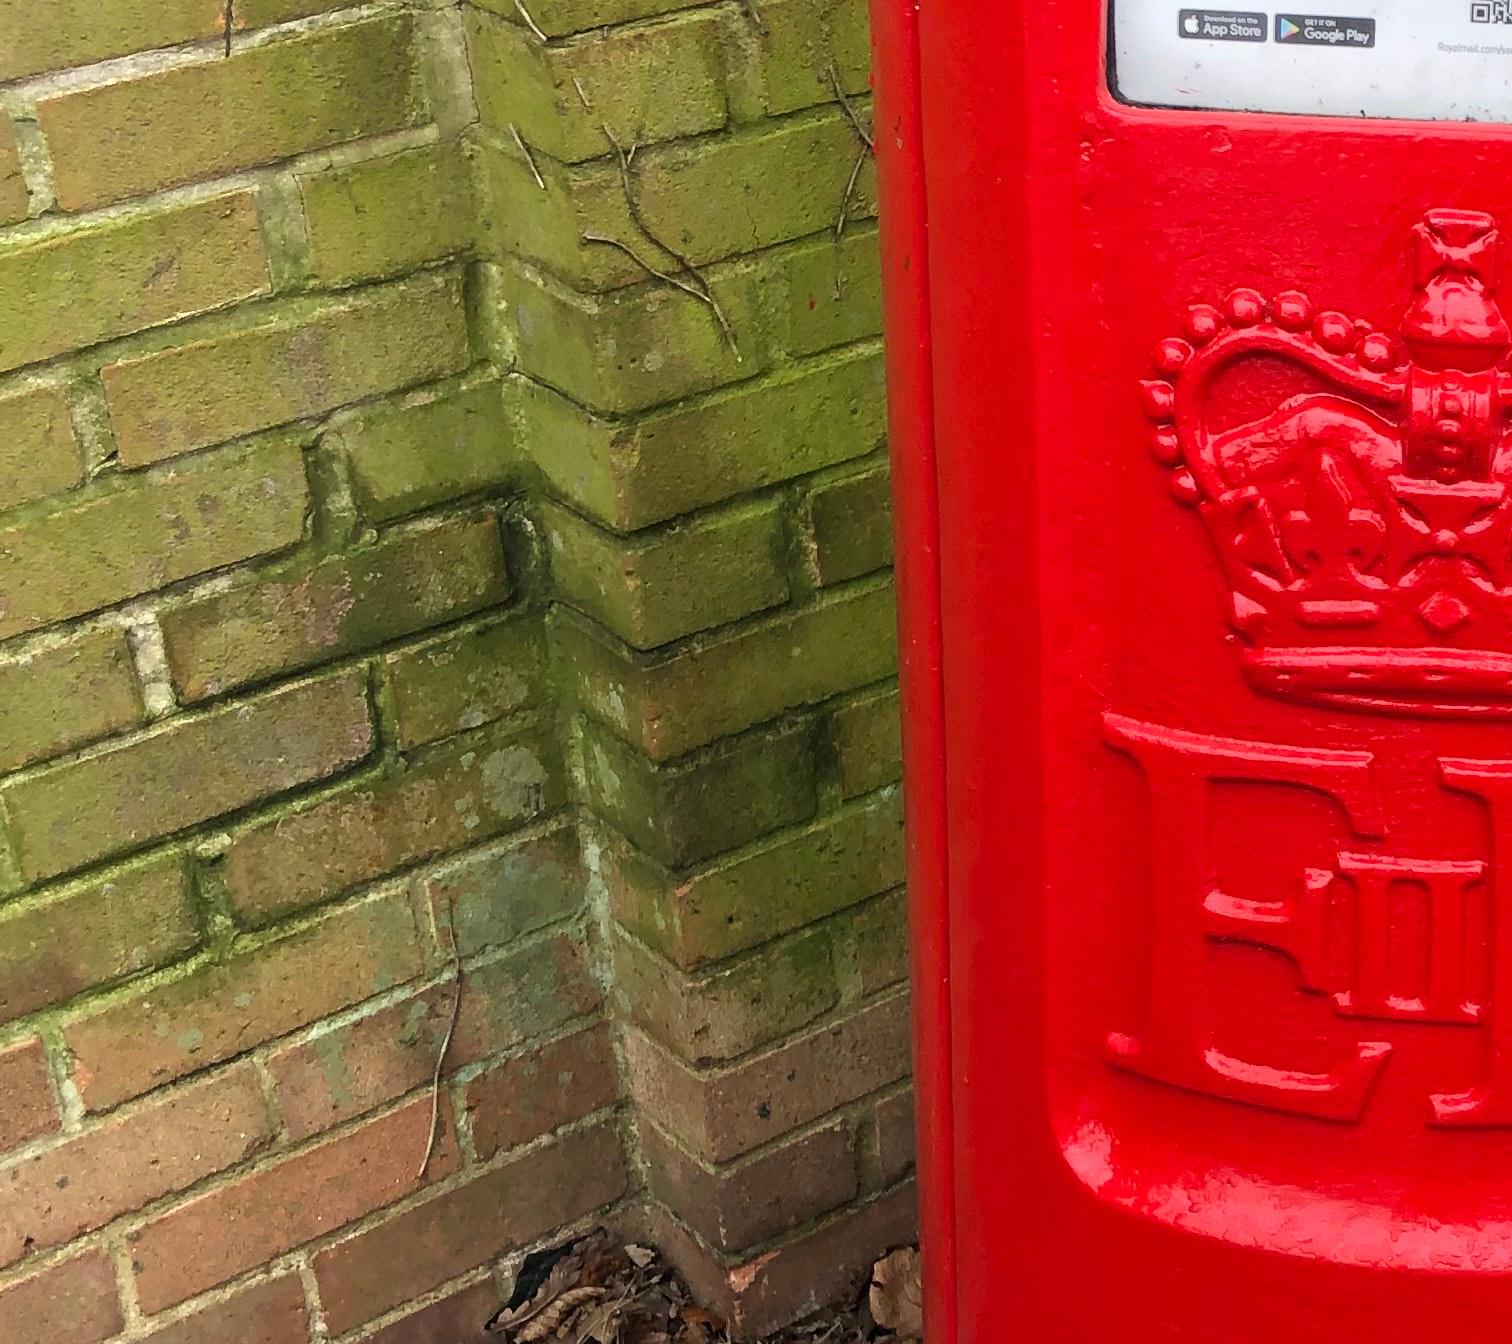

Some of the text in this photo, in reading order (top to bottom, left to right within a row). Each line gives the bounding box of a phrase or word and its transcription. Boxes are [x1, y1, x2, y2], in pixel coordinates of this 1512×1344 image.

[1203, 22, 1261, 37] App Store
[1304, 26, 1369, 44] Google Play
